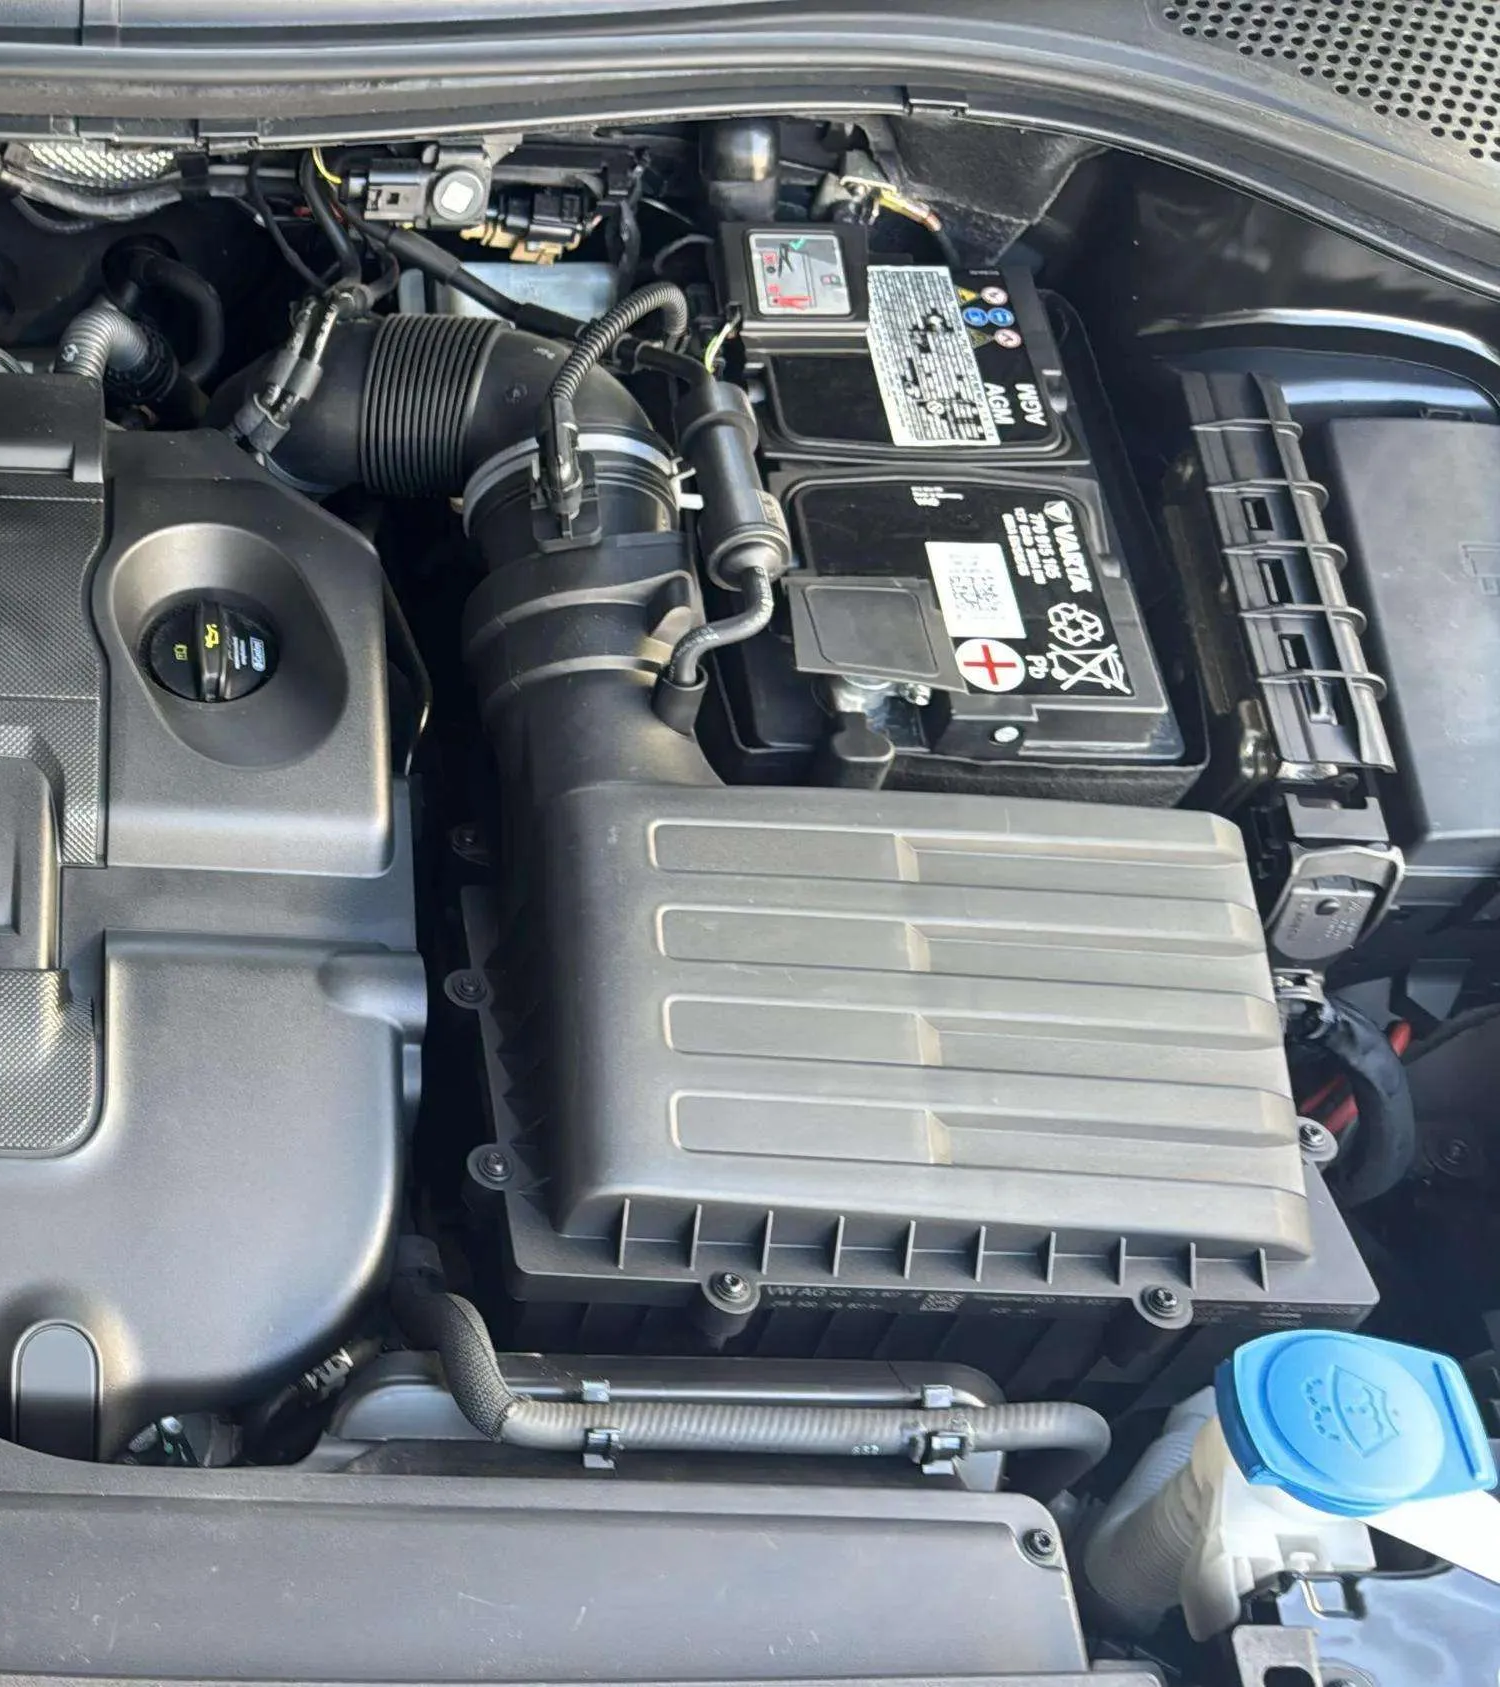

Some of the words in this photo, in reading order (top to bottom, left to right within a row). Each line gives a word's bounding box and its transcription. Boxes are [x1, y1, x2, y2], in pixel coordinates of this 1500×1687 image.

[984, 382, 1015, 425] AGM
[1015, 383, 1047, 426] AGM
[1053, 524, 1092, 592] VARTA
[1025, 655, 1048, 678] Pb
